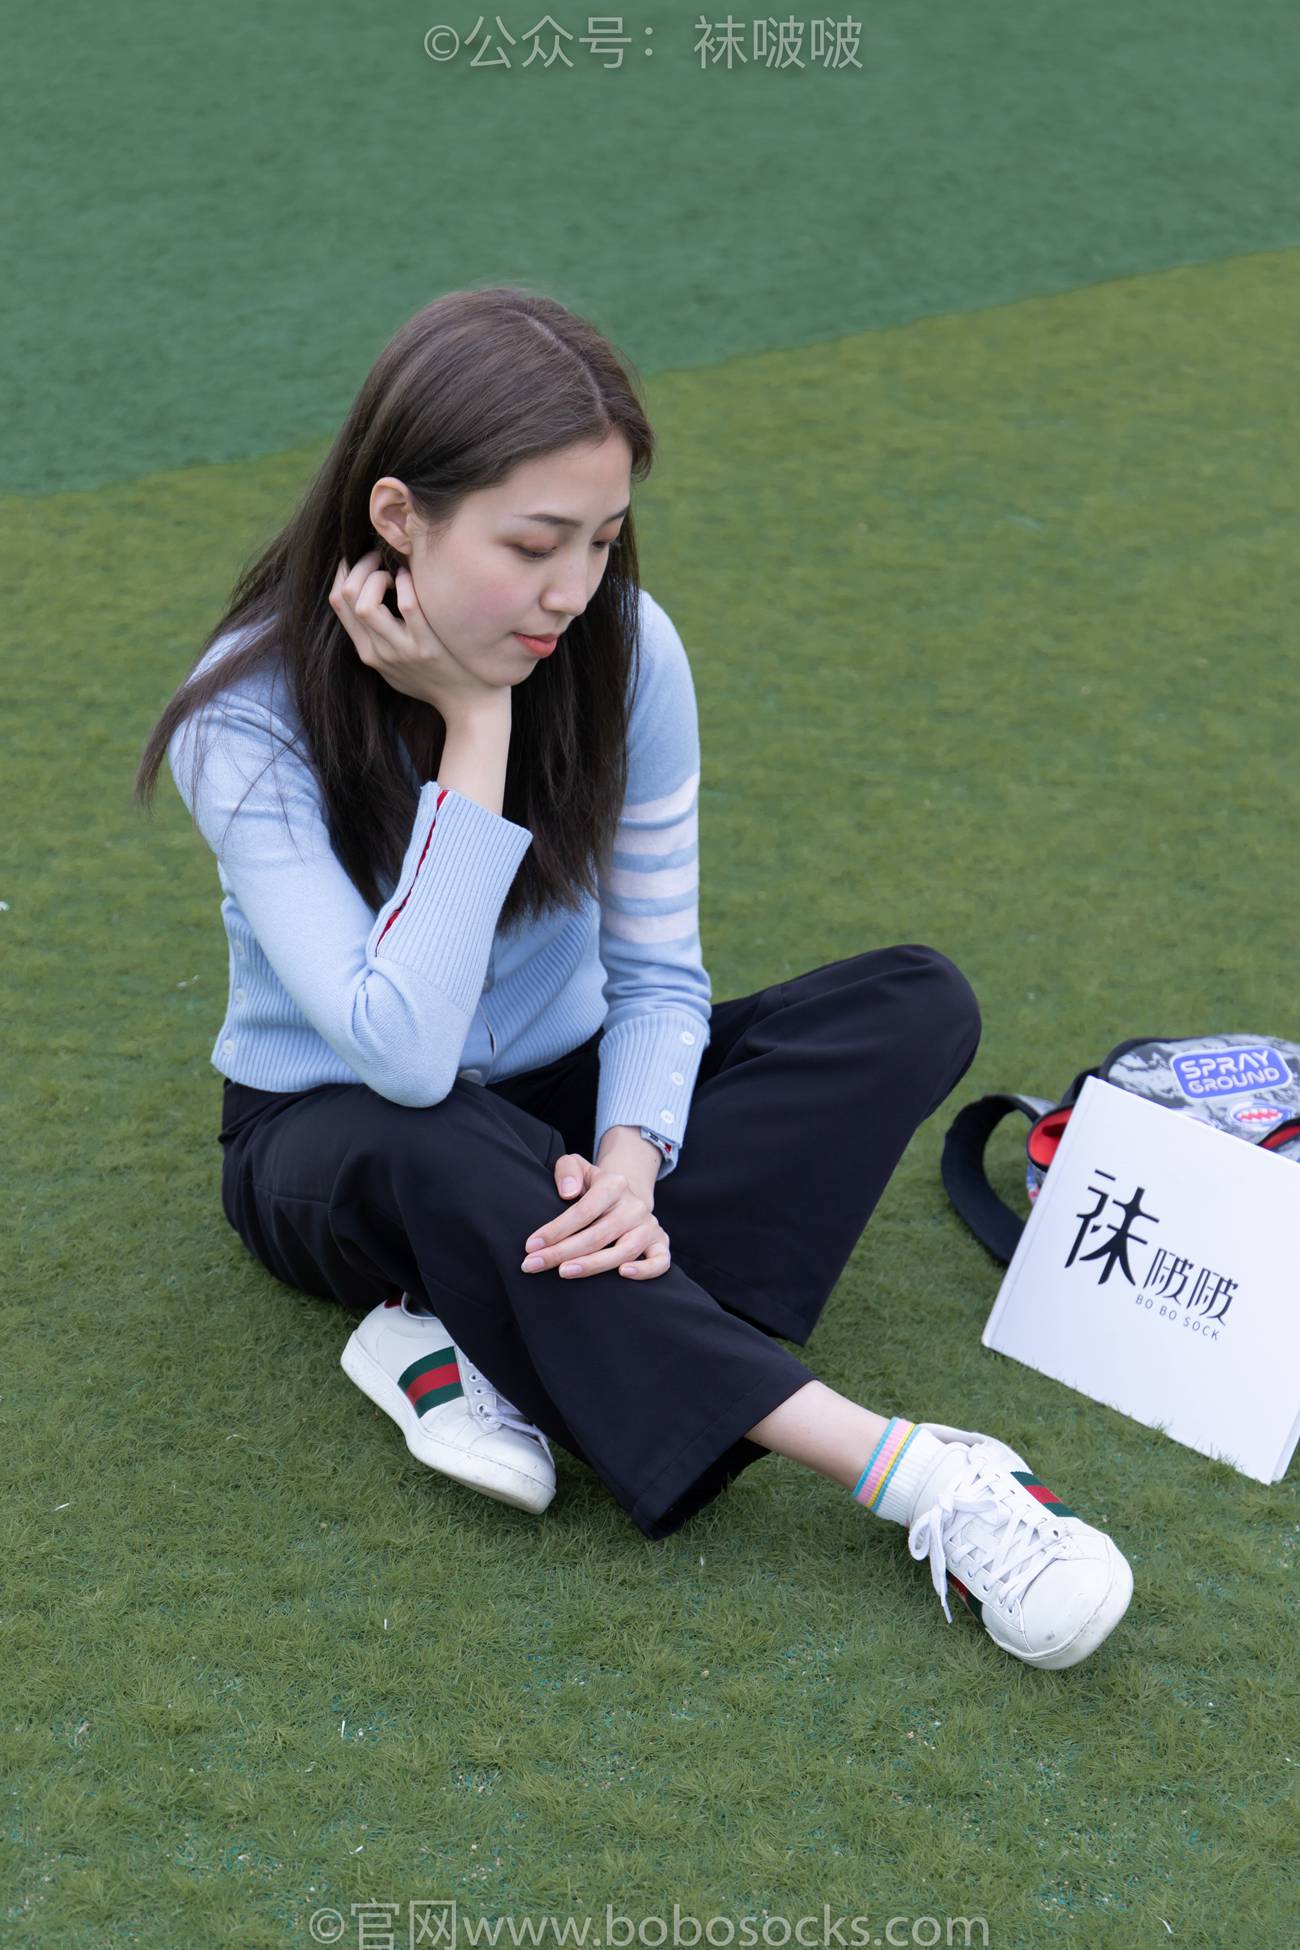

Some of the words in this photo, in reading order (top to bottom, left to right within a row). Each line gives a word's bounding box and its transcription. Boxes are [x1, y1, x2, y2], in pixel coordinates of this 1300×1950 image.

[1180, 1049, 1270, 1080] SPRAY
[1188, 1067, 1281, 1095] GROUND
[1135, 1294, 1154, 1310] BO
[1159, 1305, 1178, 1321] BO
[1183, 1316, 1220, 1341] SOCK
